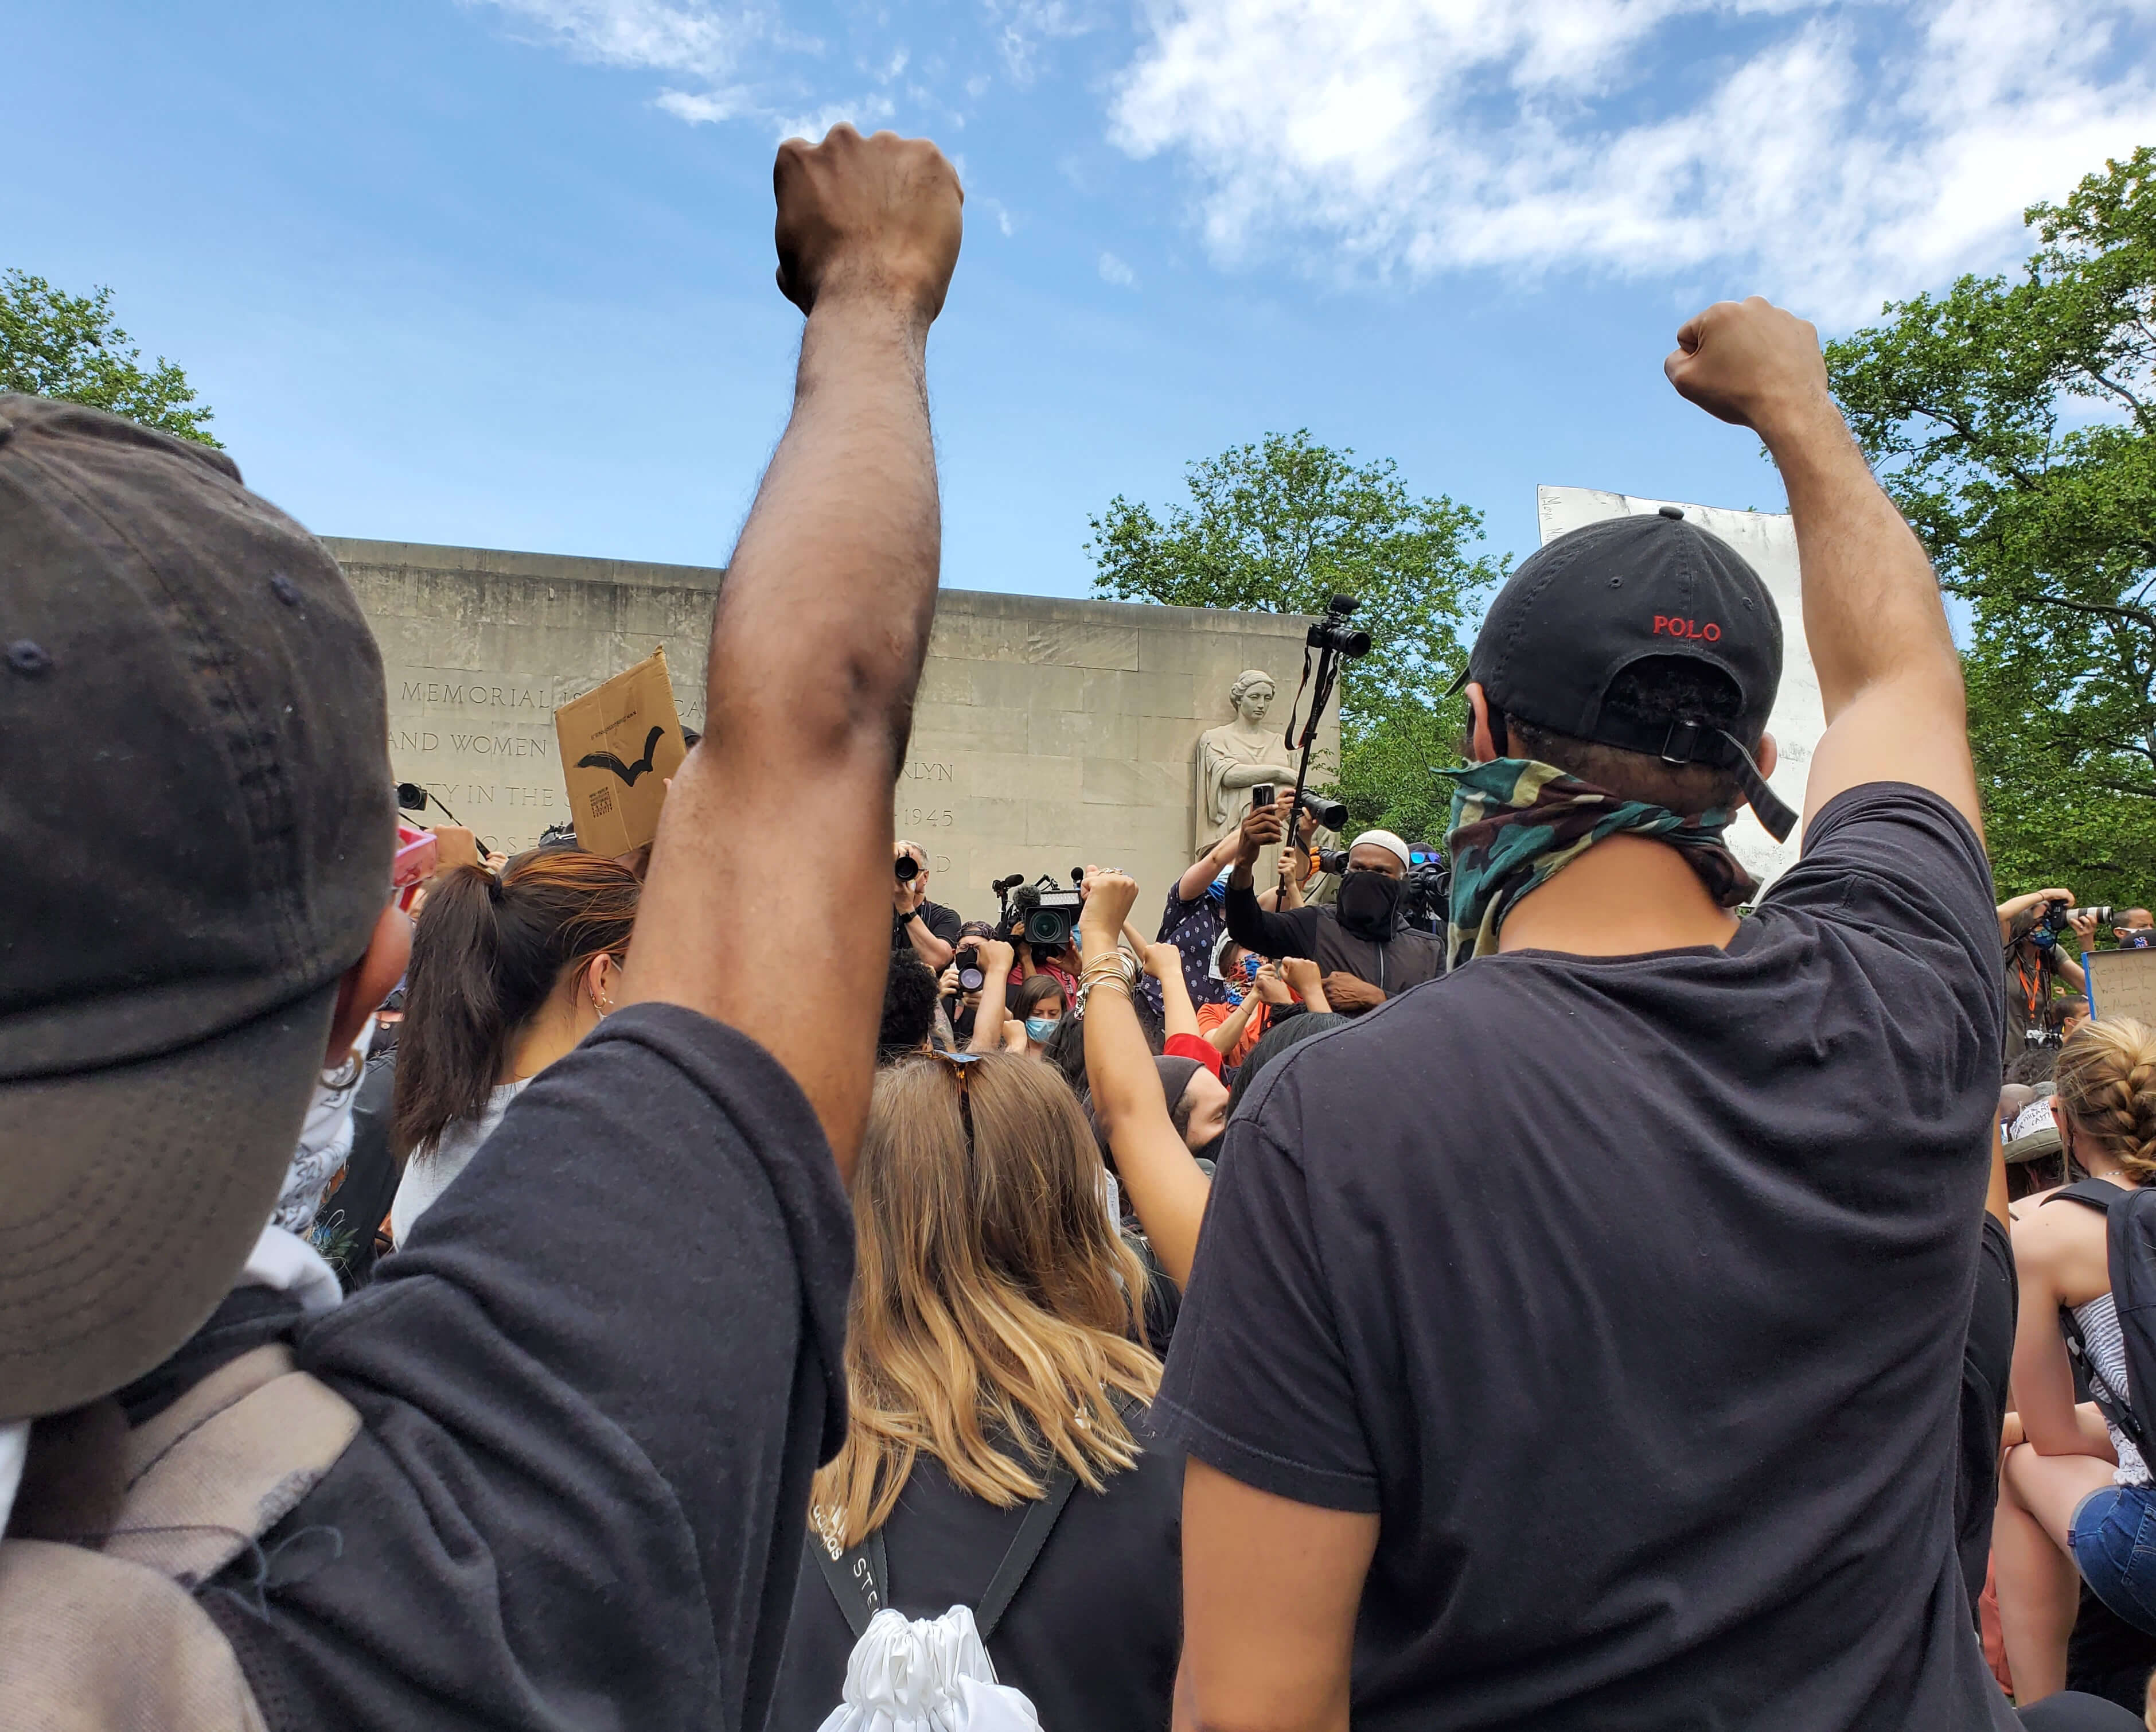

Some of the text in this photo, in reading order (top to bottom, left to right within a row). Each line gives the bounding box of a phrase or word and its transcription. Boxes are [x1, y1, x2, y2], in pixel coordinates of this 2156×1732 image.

[1652, 615, 1721, 642] POLO
[401, 682, 549, 709] MEMORIAL
[387, 730, 439, 751] AND
[450, 734, 547, 757] WOMEN
[467, 785, 495, 804] IN
[505, 787, 554, 807] THE
[904, 808, 953, 827] 1945
